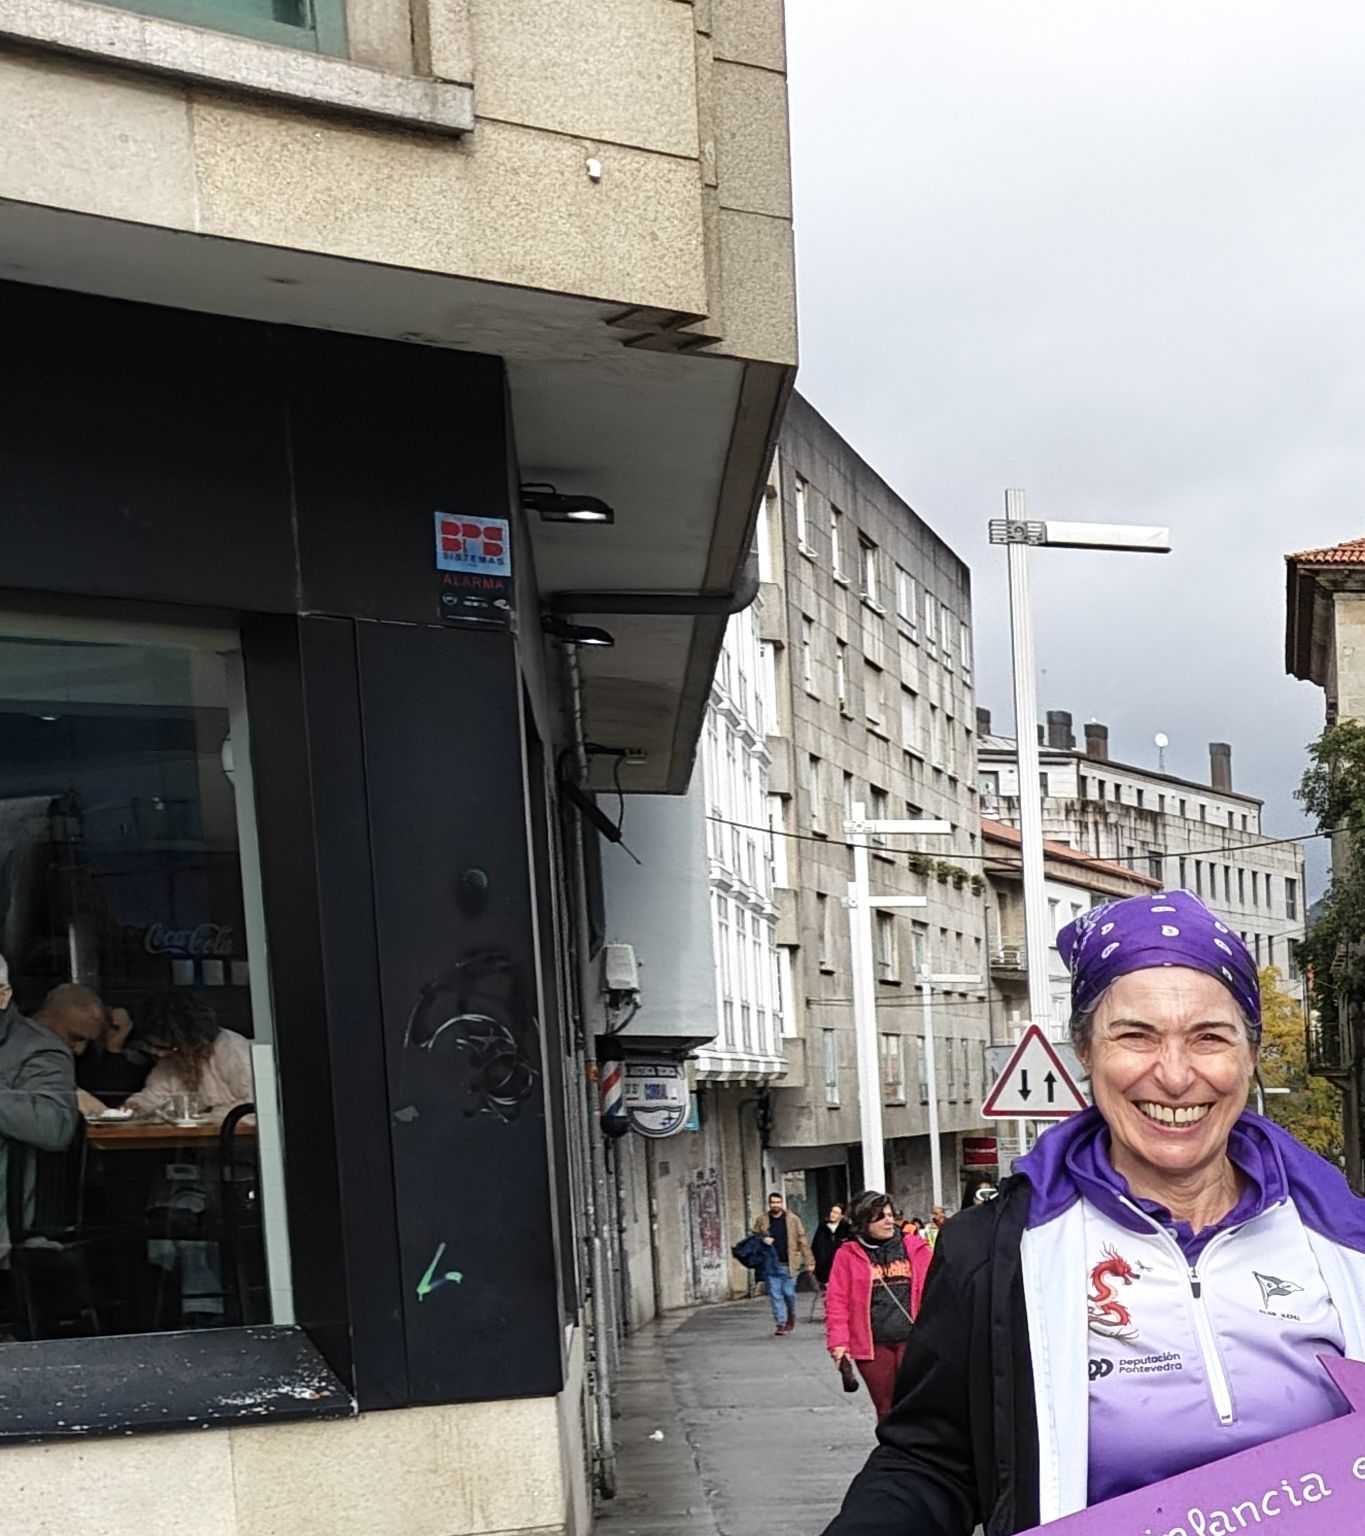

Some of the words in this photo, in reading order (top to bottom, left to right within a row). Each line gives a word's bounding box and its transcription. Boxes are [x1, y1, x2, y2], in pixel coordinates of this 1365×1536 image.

[443, 574, 504, 591] ALARMA
[1119, 1351, 1181, 1366] Deputación
[1119, 1361, 1183, 1374] Pontevedra
